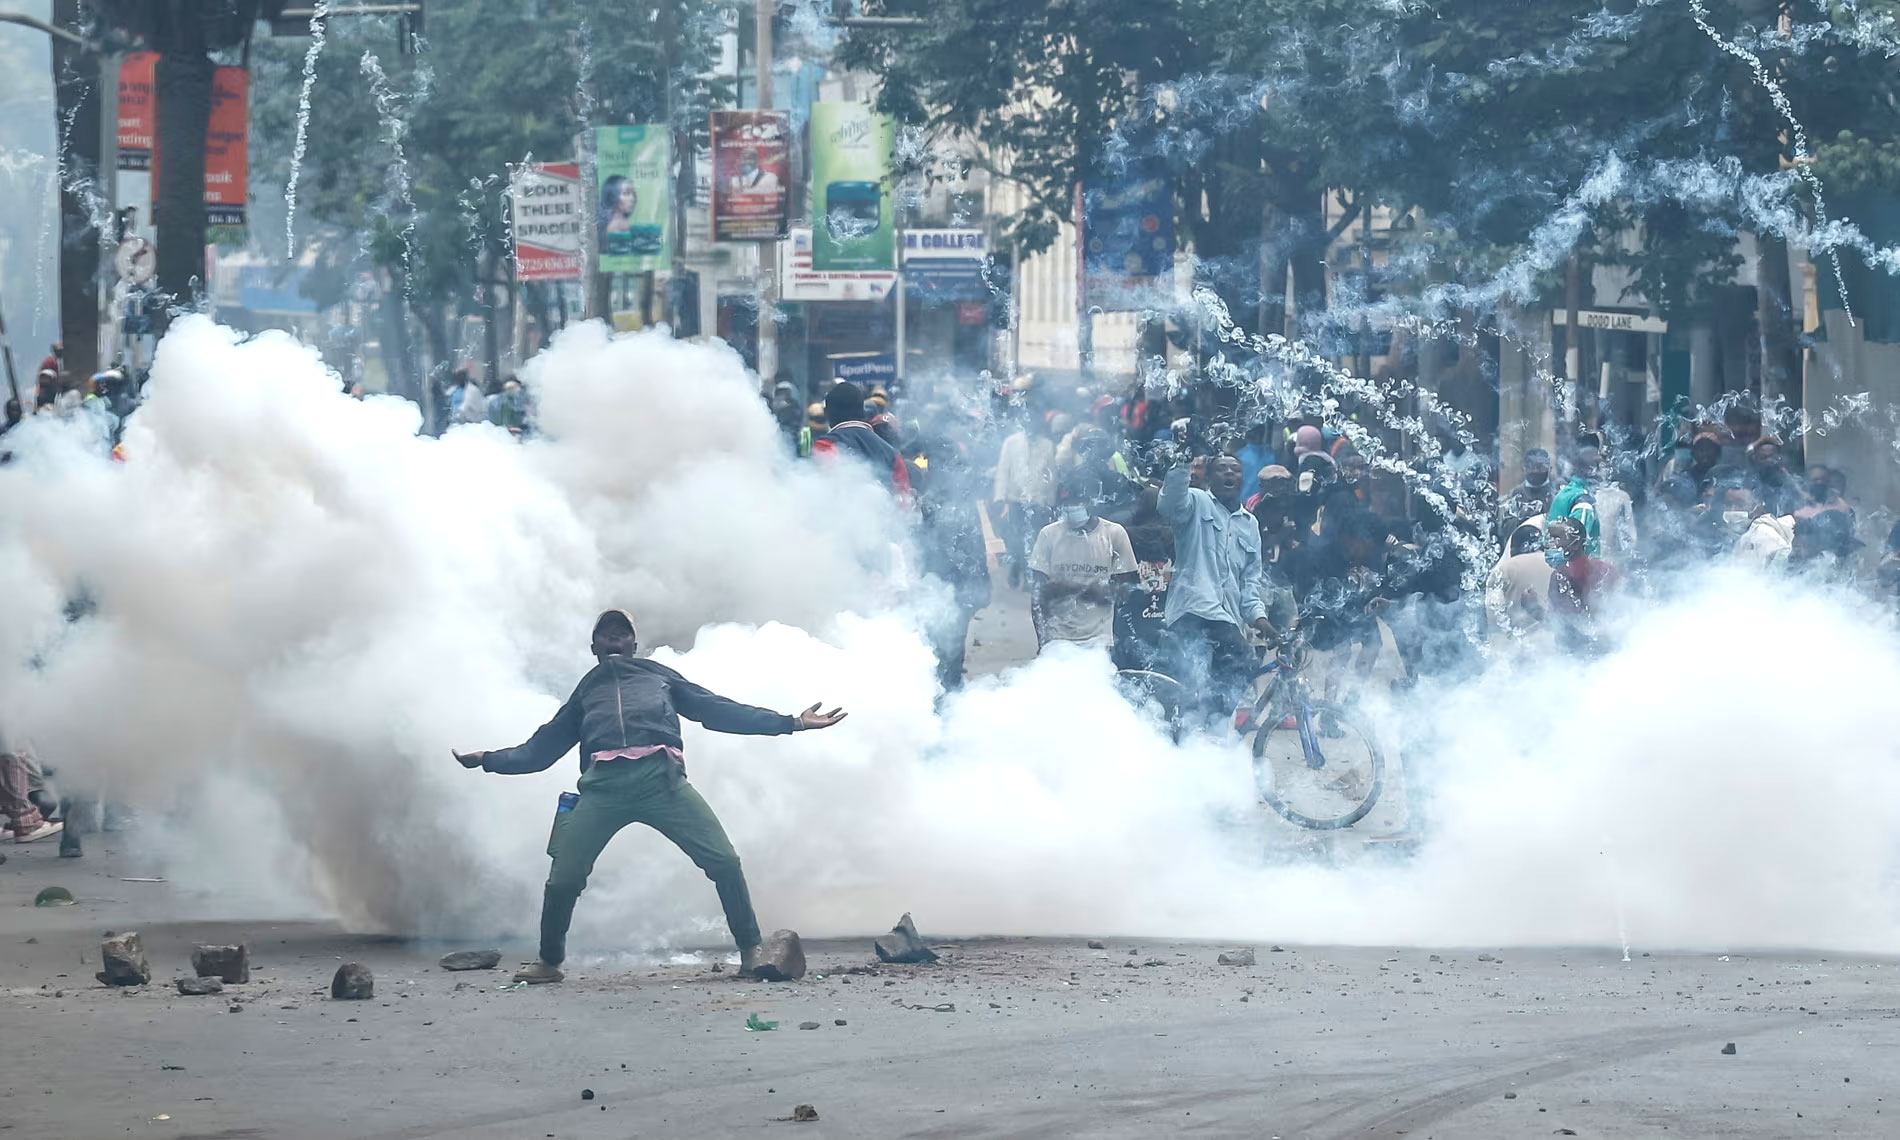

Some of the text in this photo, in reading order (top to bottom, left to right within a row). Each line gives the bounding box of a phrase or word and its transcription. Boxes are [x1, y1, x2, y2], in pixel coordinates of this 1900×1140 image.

[520, 203, 573, 216] THESE
[922, 234, 985, 248] COLLEGE
[1611, 315, 1633, 329] LANE
